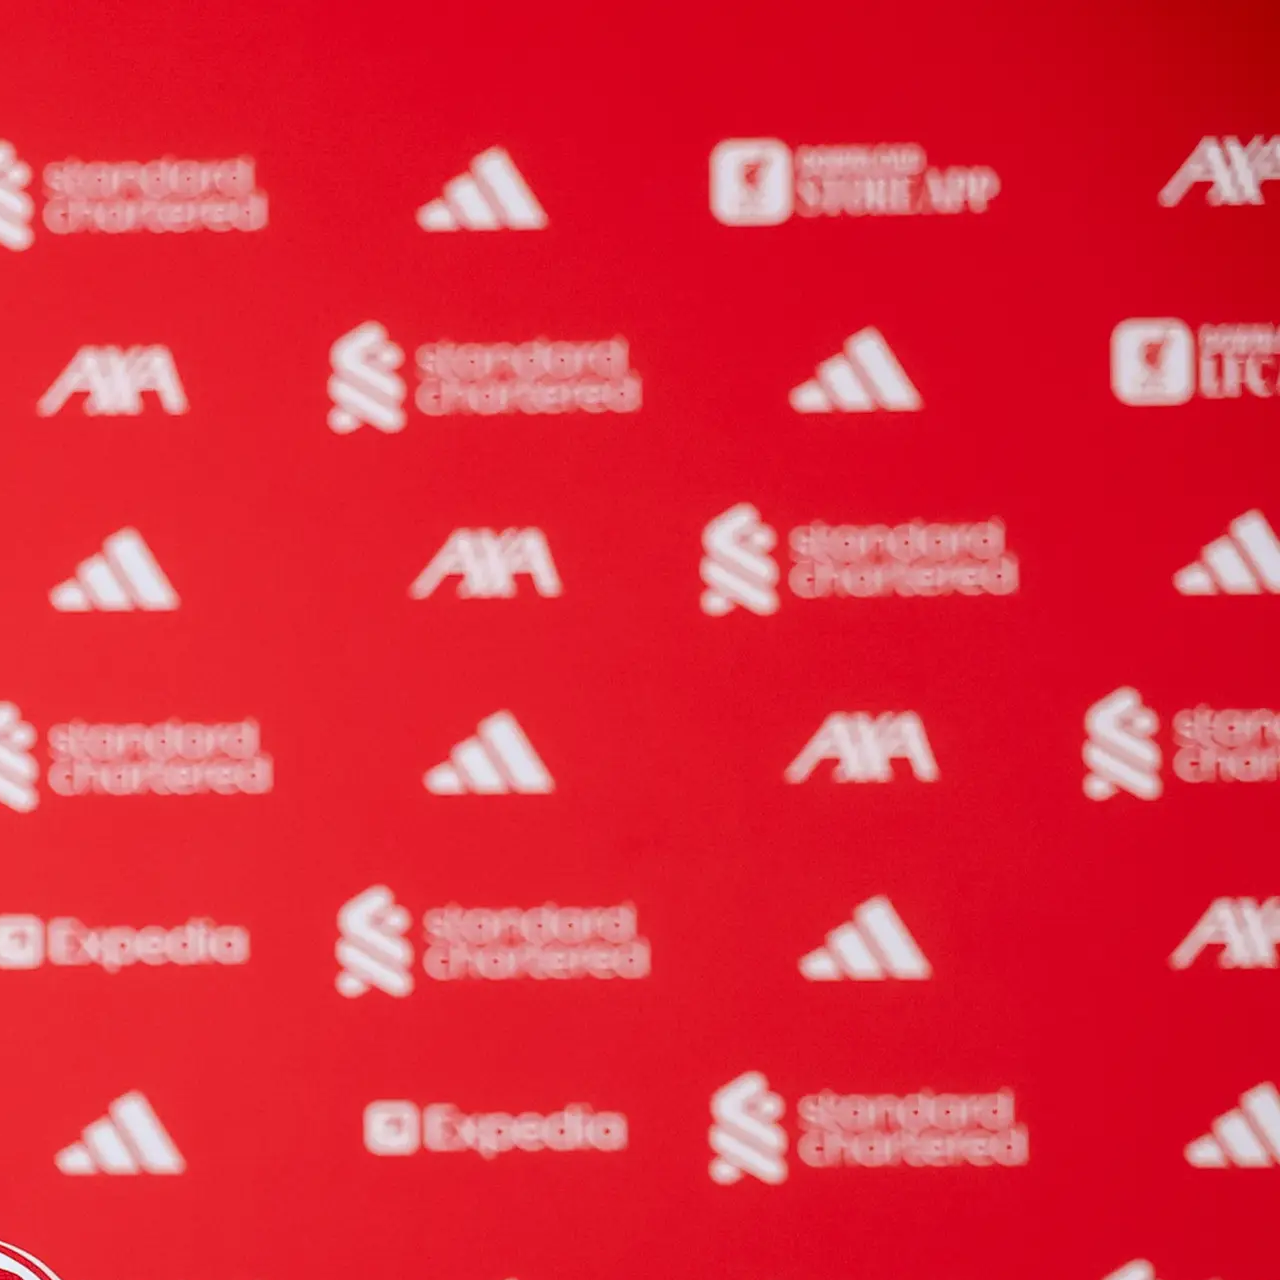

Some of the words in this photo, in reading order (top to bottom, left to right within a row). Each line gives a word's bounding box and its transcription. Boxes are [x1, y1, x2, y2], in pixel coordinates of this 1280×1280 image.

[42, 158, 257, 198] standard
[42, 196, 269, 235] chartered
[414, 340, 631, 380] standard
[37, 344, 189, 417] AXA
[414, 378, 643, 416] chartered
[789, 522, 1007, 562] standard
[410, 527, 562, 599] AXA
[789, 560, 1020, 599] chartered
[48, 719, 262, 760] standard
[1172, 703, 1280, 748] stan
[785, 711, 938, 783] AXA
[48, 758, 273, 796] chartered
[422, 904, 640, 944] standard
[48, 917, 250, 973] Expedia
[422, 942, 651, 981] chartered
[799, 1090, 1017, 1130] standard
[426, 1102, 628, 1160] Expedia
[799, 1128, 1029, 1168] chartered
